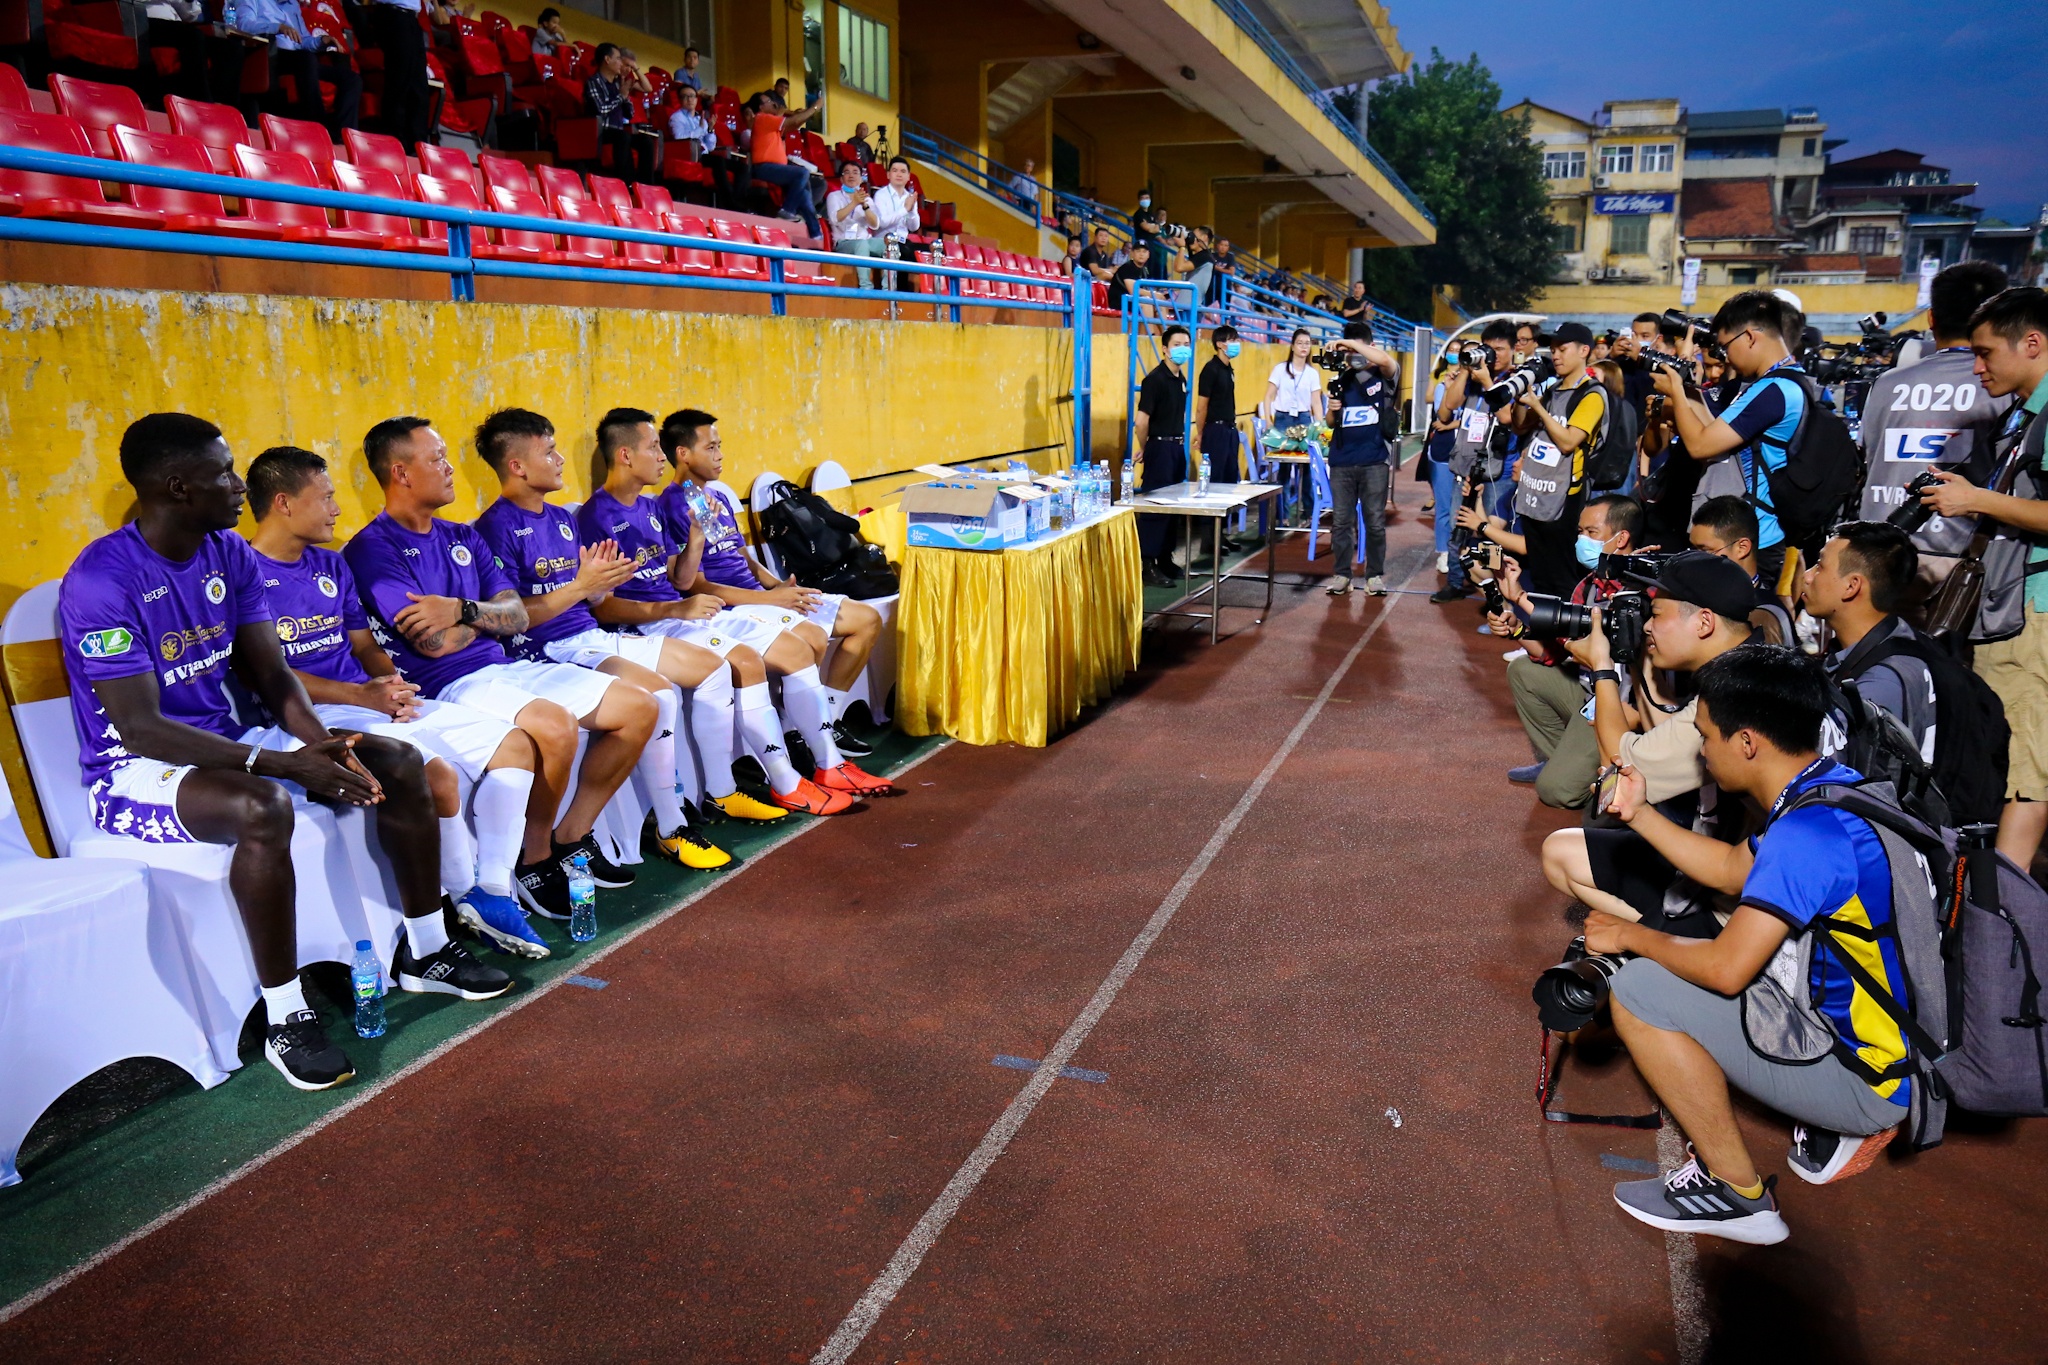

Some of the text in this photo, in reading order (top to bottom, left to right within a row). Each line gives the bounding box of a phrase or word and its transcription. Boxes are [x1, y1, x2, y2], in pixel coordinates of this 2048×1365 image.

[1890, 383, 1976, 412] 2020
[1344, 409, 1369, 425] LS
[1531, 443, 1547, 460] LS
[1897, 434, 1947, 459] LS
[951, 516, 988, 533] Opal
[286, 632, 344, 656] Vinawind
[1956, 856, 1967, 893] COMAN
[355, 980, 376, 992] Opal
